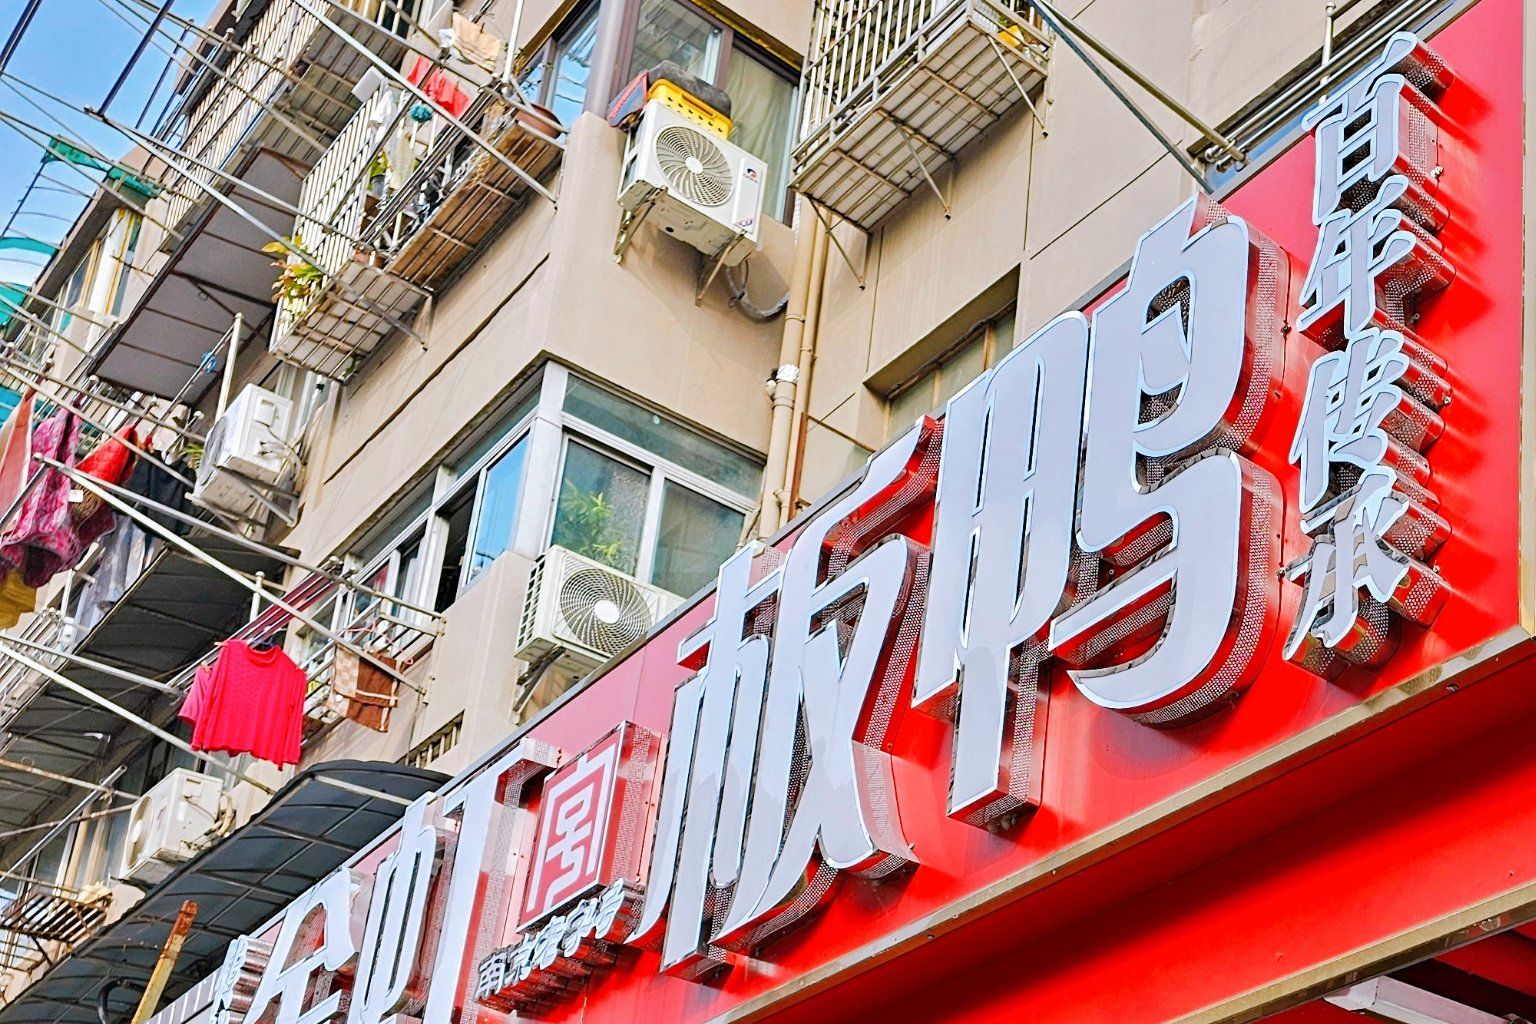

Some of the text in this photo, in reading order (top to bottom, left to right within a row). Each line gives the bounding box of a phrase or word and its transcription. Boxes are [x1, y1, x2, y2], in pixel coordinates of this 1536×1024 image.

[627, 195, 1249, 971] 板鸭
[1284, 30, 1416, 662] 百年传承
[475, 878, 626, 999] 南京老字号
